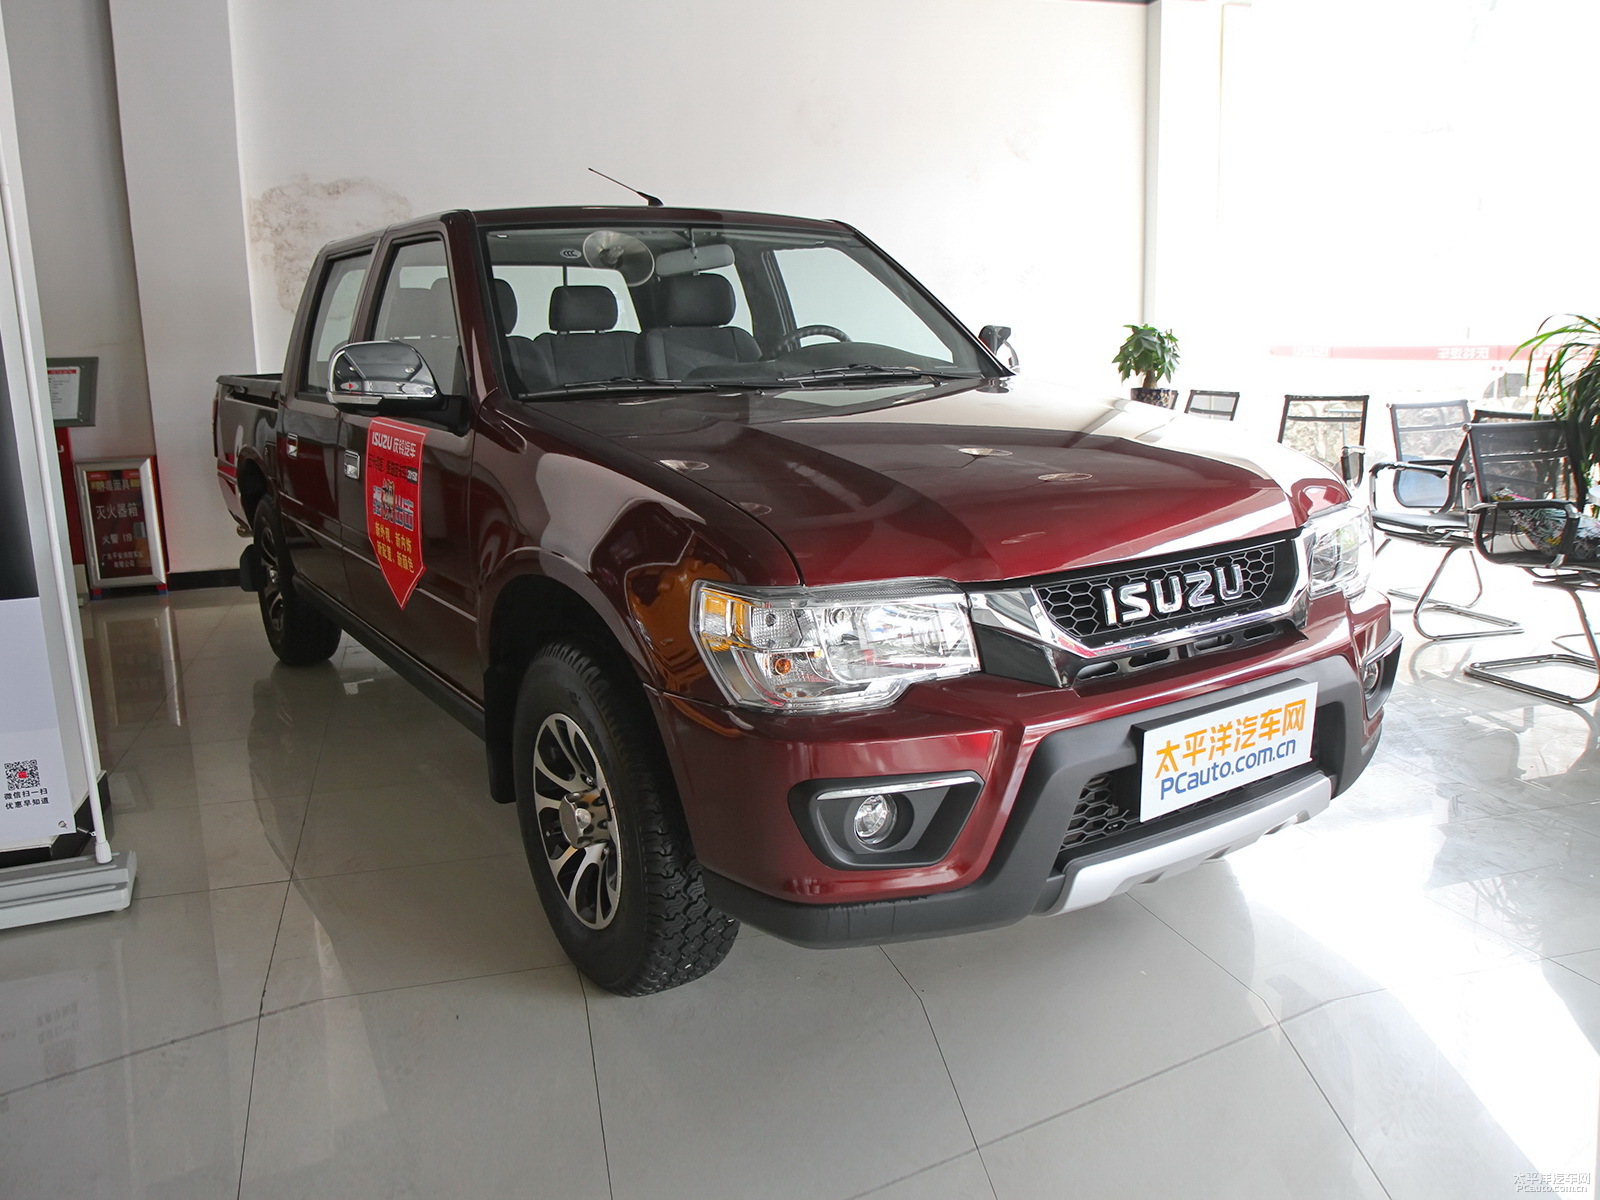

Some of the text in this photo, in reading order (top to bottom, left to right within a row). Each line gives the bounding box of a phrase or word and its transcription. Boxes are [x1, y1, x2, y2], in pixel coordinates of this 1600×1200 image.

[371, 431, 417, 459] ISUZU 庆铃汽车
[95, 502, 139, 520] 灭火器箱
[102, 533, 119, 545] 火警
[1101, 564, 1243, 627] ISUZU
[1155, 698, 1307, 779] 太平洋汽车网
[1160, 739, 1296, 801] PCauto.com.cn
[4, 788, 48, 800] 微信扫一扫
[5, 797, 49, 810] 优惠早知道
